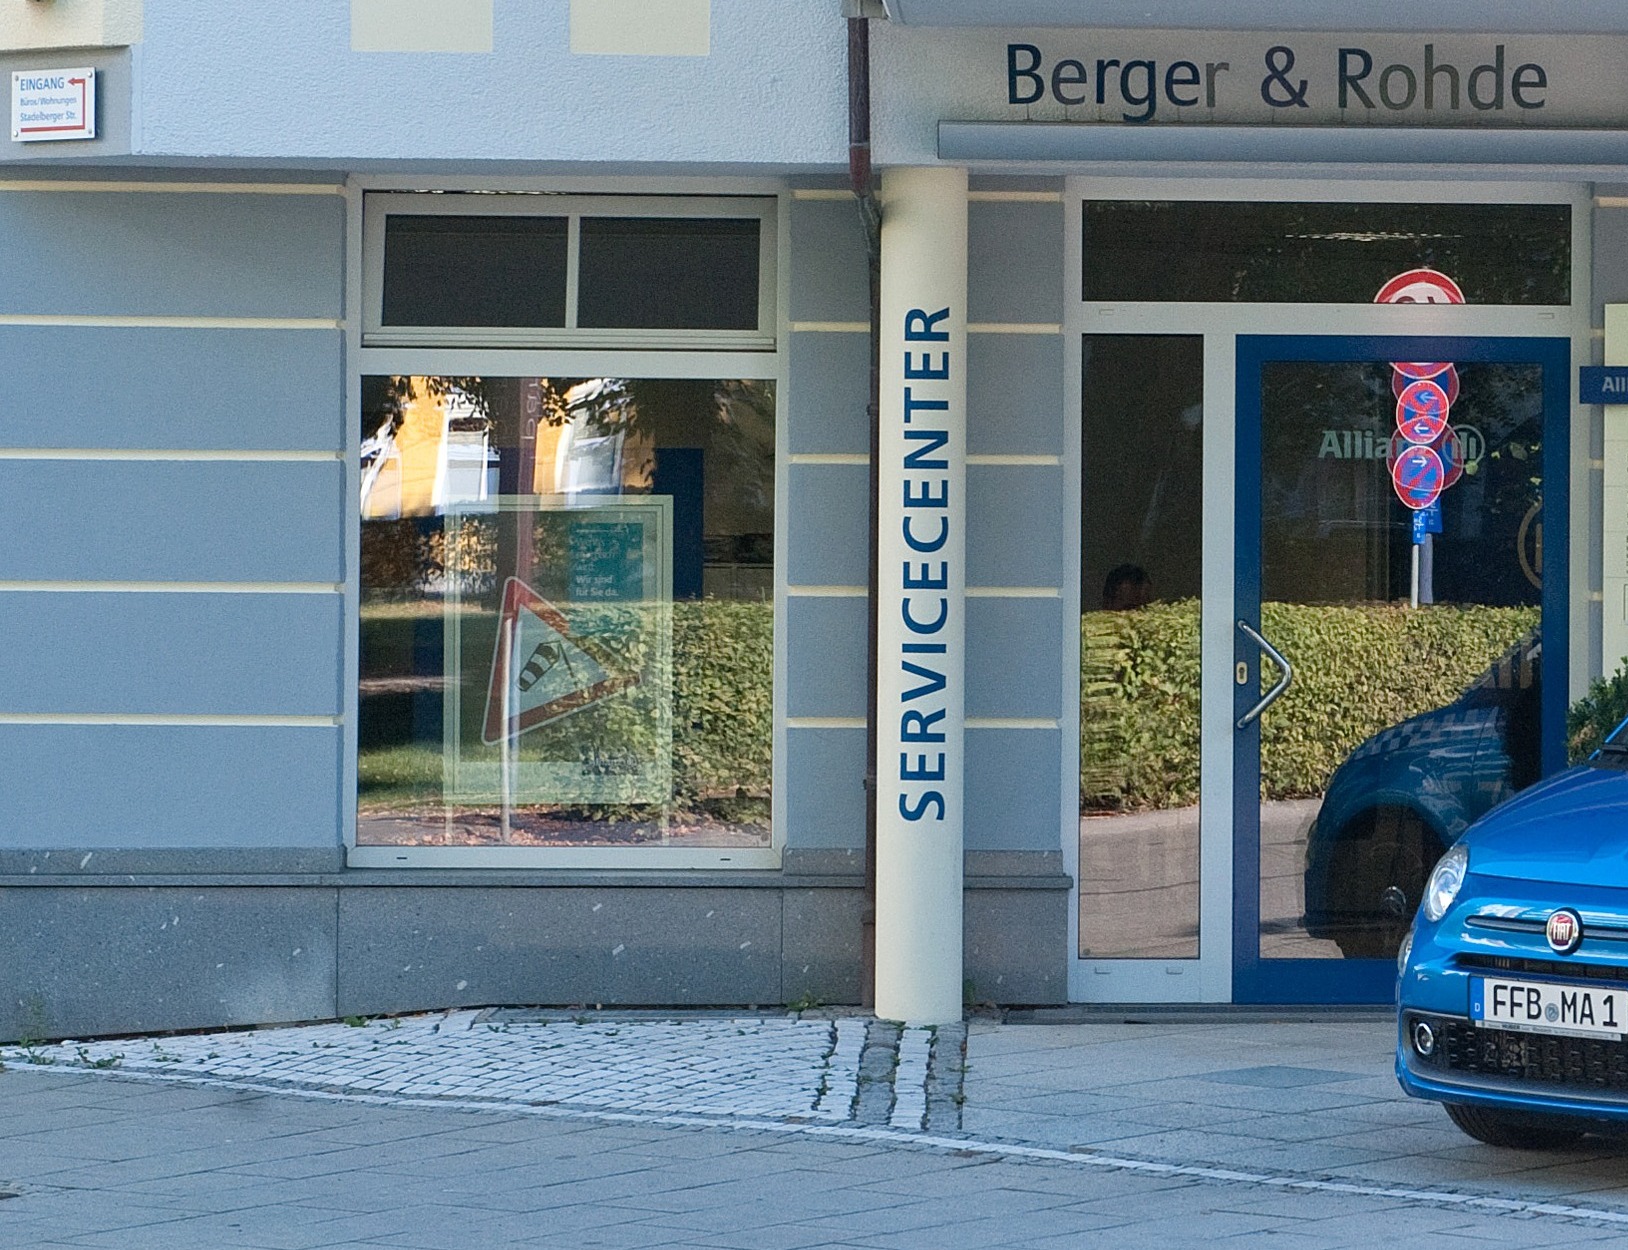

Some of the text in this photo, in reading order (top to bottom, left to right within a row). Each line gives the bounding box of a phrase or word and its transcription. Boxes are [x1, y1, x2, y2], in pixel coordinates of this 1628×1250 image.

[20, 77, 65, 91] EINGANG
[1006, 43, 1549, 122] Berger & Rohde
[899, 306, 951, 821] SERVICECENTER
[1552, 922, 1572, 941] FIAT
[1474, 1002, 1481, 1012] D
[1493, 984, 1618, 1027] FFB MA 1
